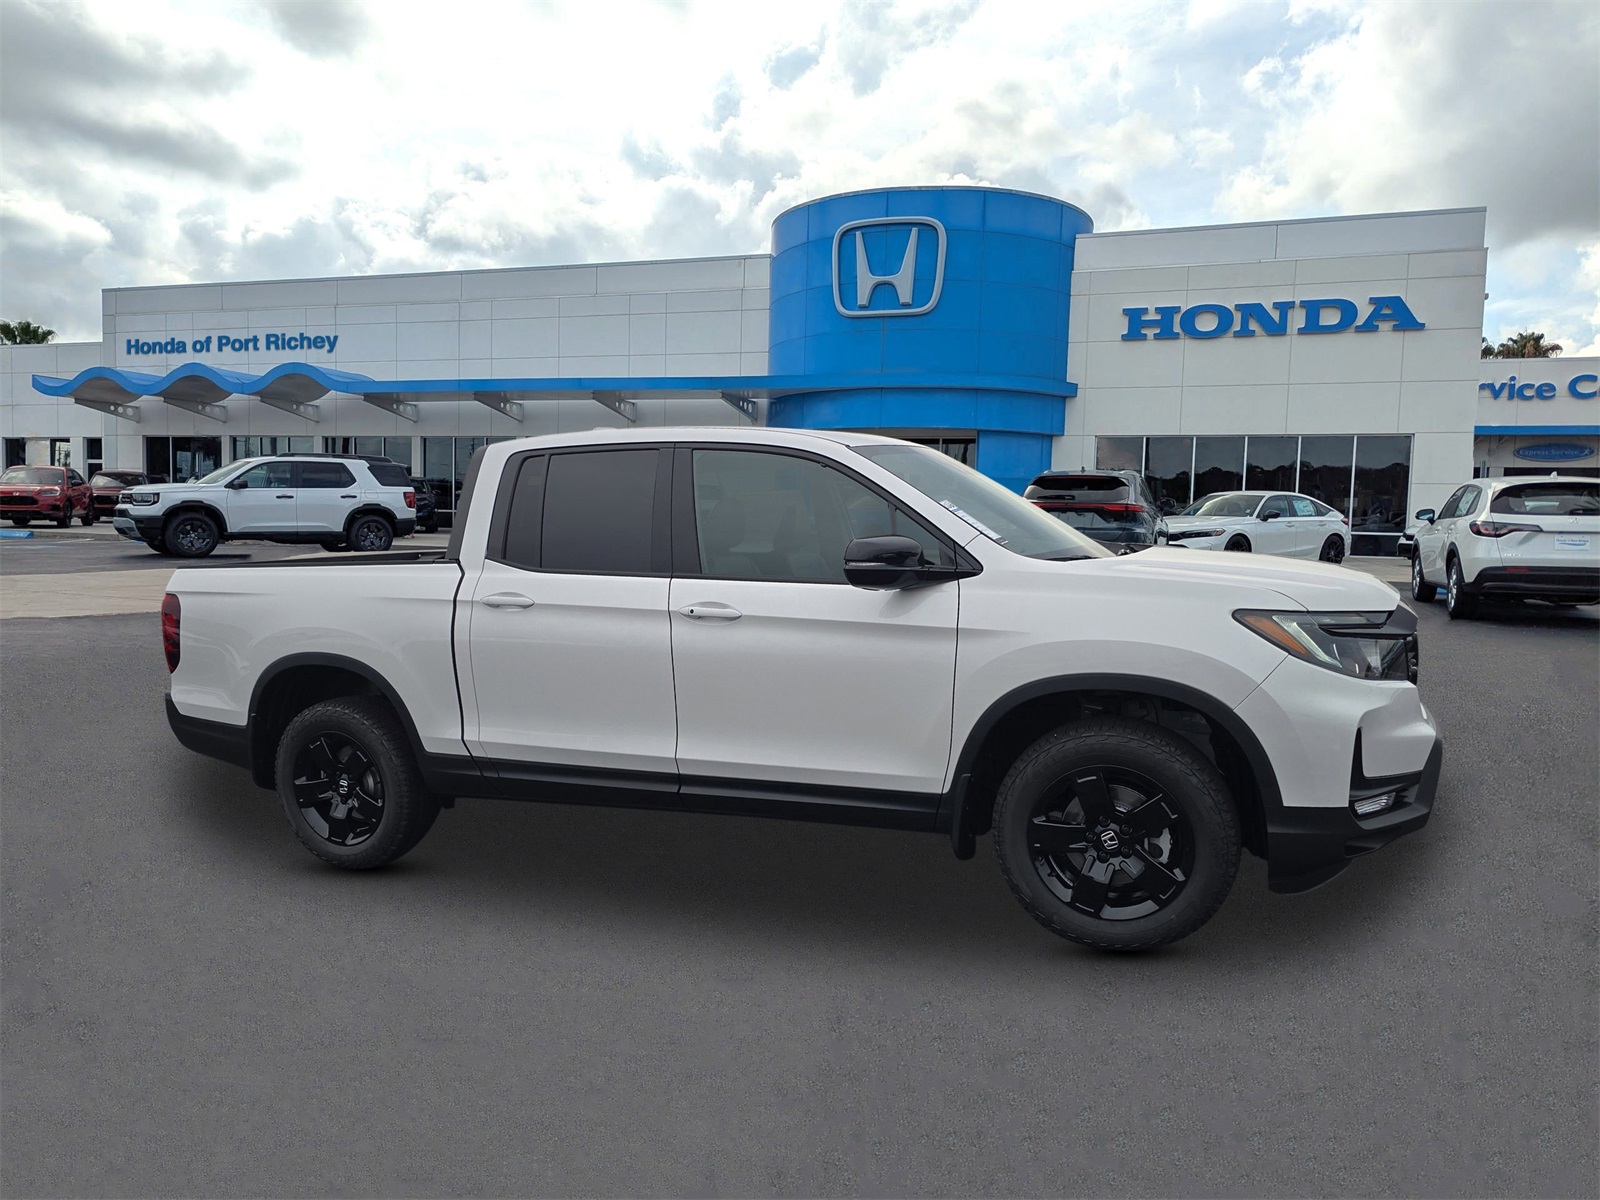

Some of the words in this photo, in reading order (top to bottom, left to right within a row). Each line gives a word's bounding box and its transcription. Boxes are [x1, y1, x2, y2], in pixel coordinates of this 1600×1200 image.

[1121, 295, 1426, 341] HONDA
[125, 337, 188, 356] Honda
[190, 335, 212, 354] of
[216, 334, 260, 353] Port
[264, 332, 339, 354] Richey
[1567, 373, 1600, 400] C
